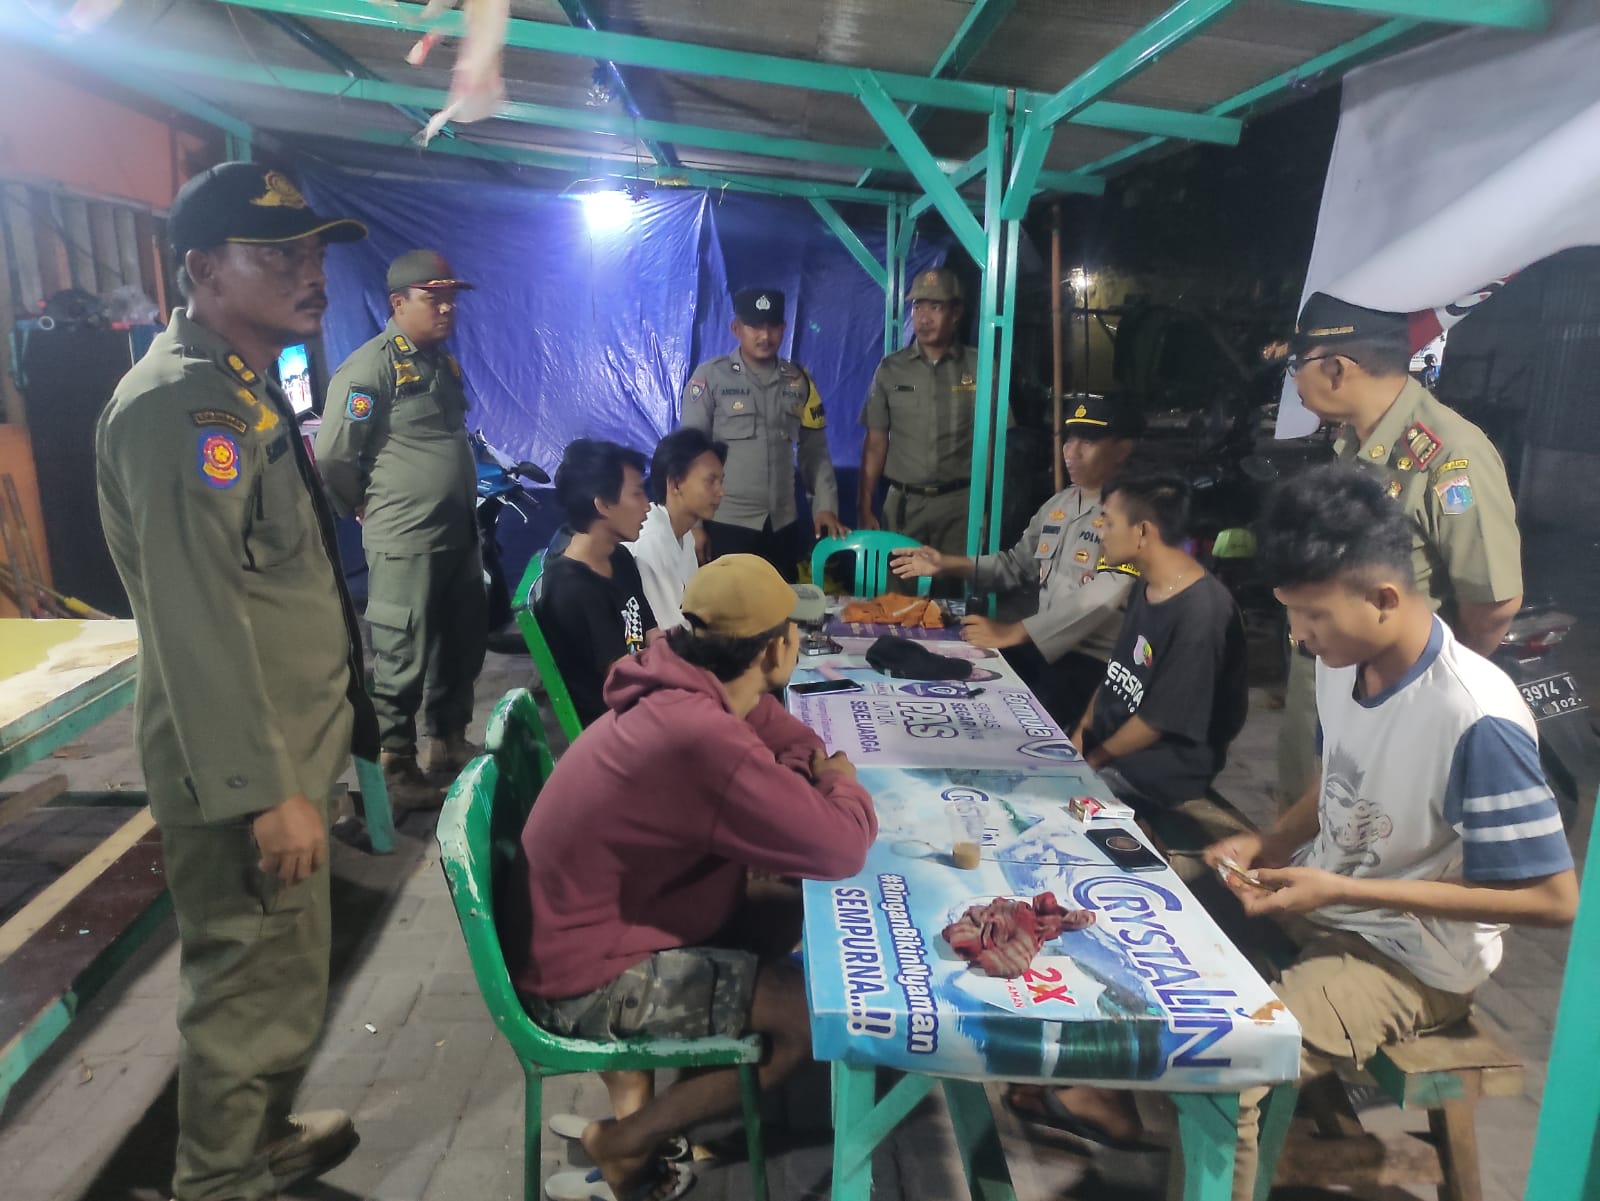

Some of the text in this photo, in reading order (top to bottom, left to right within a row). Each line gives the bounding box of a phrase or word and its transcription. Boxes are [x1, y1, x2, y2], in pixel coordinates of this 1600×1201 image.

[1522, 681, 1560, 702] 3974
[850, 701, 881, 753] SEKELUARGA
[873, 702, 897, 726] UNTUK
[897, 701, 959, 739] PAS
[877, 873, 942, 1055] #RinganBikinNyaman
[1008, 985, 1024, 1008] AMAN
[1023, 966, 1079, 1009] 2X
